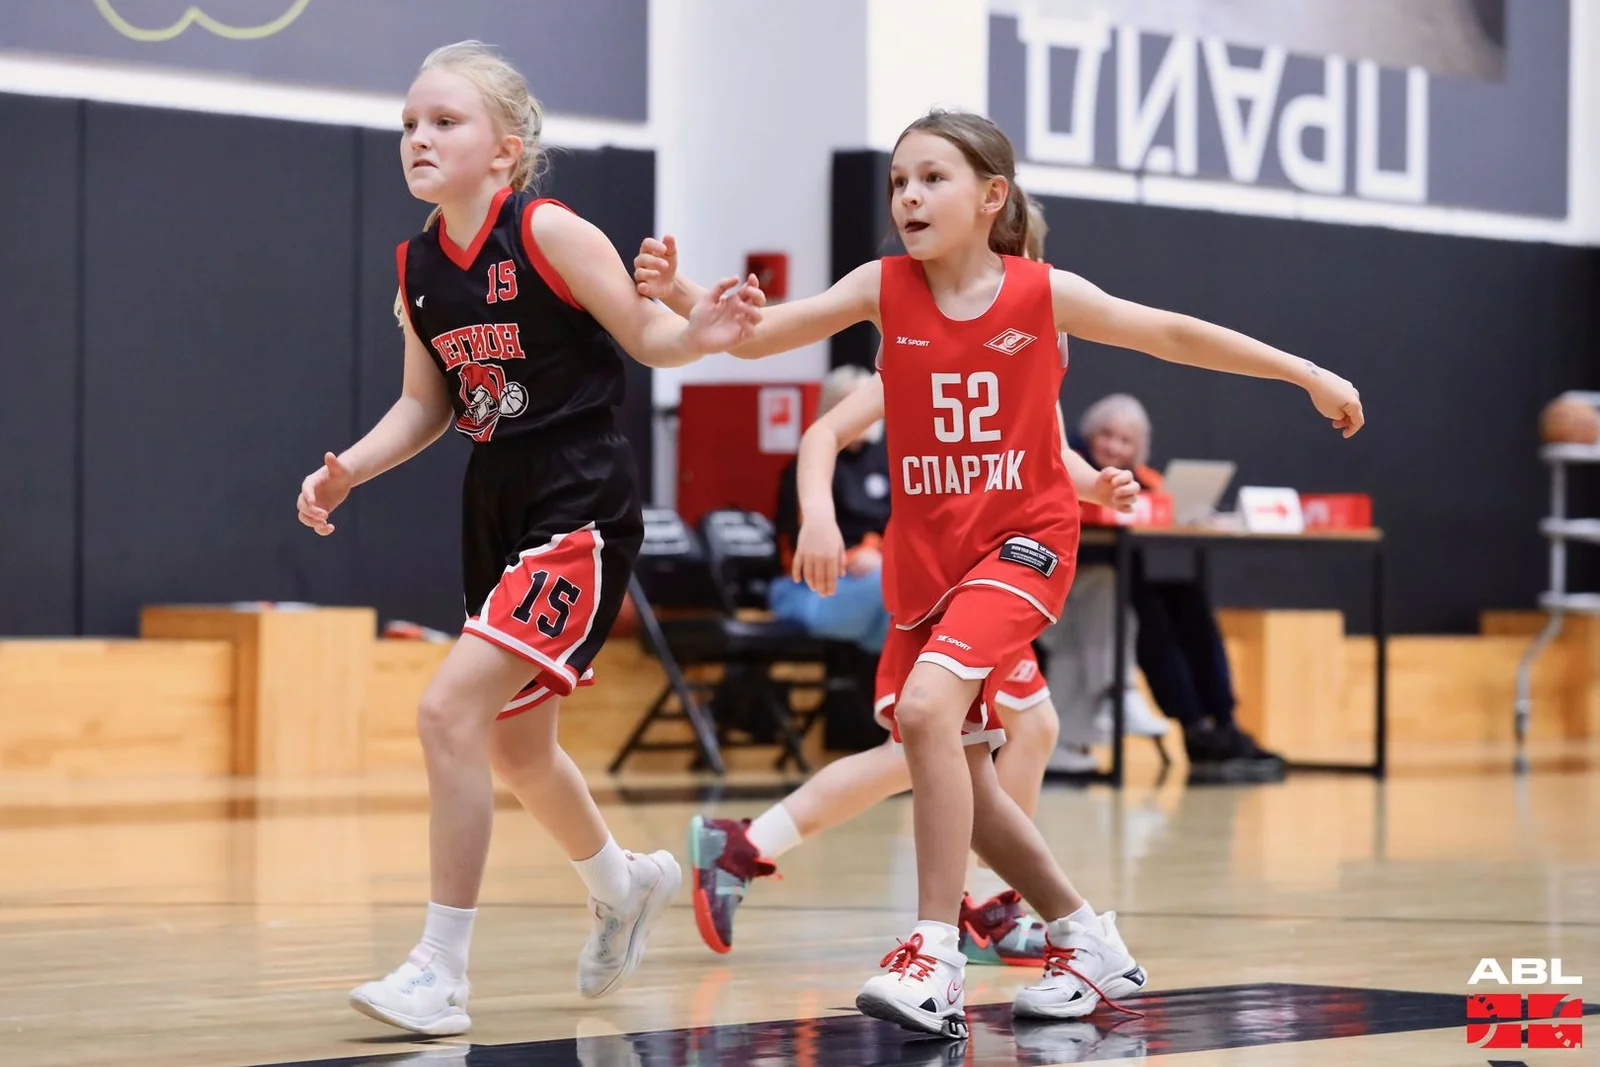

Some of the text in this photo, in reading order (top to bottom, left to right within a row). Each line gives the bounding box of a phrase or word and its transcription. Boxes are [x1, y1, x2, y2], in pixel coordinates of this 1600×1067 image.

[1016, 6, 1428, 202] ПРАЙД
[486, 259, 519, 304] 15
[908, 339, 930, 347] SPORT
[931, 371, 1001, 443] 52
[902, 450, 1026, 495] СПАРТАК
[511, 570, 582, 639] 15
[947, 638, 972, 651] SPORT
